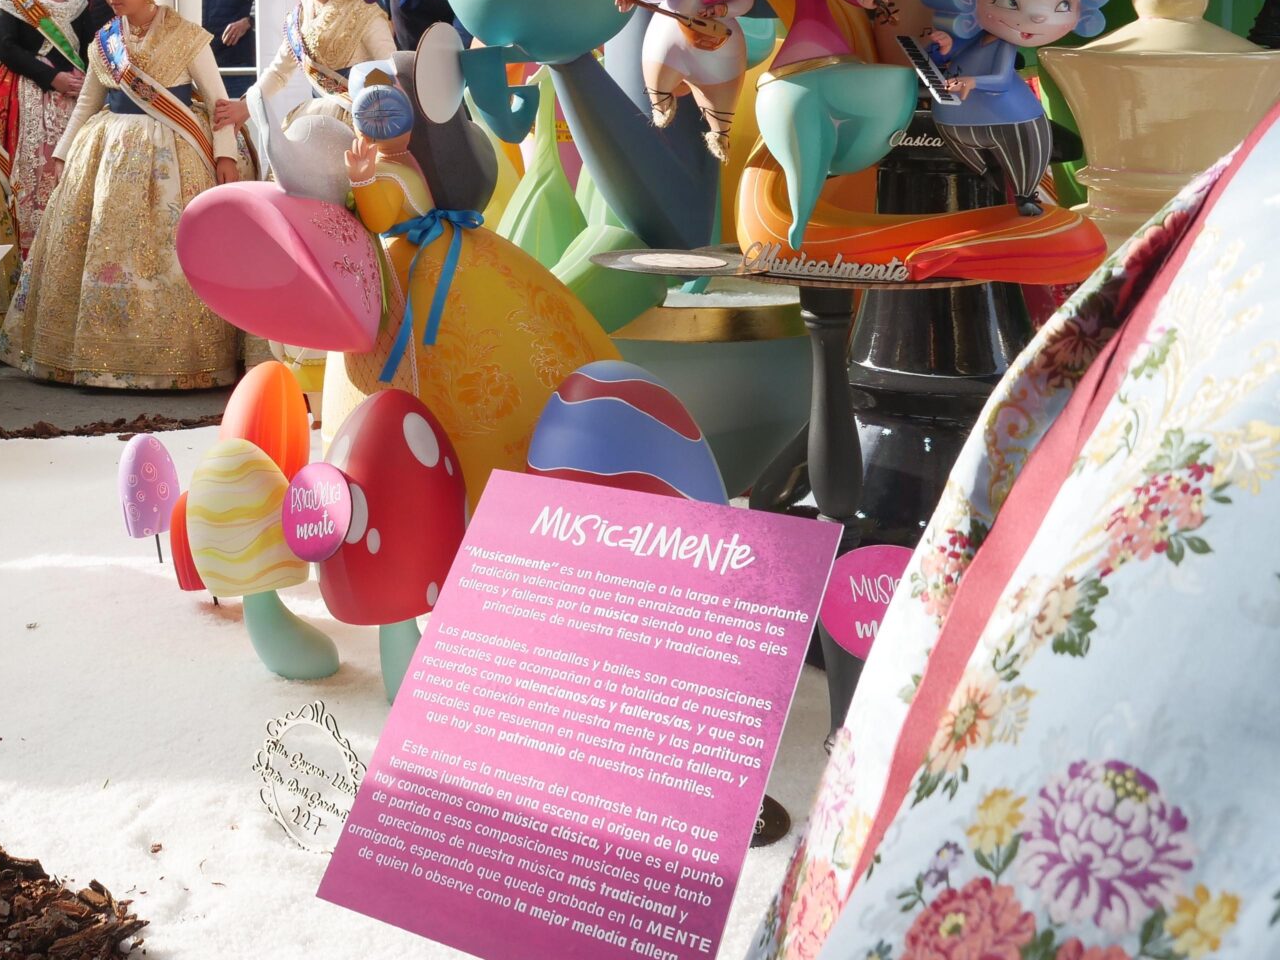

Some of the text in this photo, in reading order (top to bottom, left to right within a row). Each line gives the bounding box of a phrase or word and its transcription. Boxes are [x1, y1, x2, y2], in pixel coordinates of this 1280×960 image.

[889, 129, 945, 148] Clasica
[742, 241, 910, 282] Musicalmente
[296, 510, 336, 540] mente
[458, 576, 788, 656] falleros y falleras por la música siendo uno de los ejes
[470, 562, 785, 637] tradición valenciana que tan enraizada tenemos los
[481, 600, 741, 665] principales de nuestra fiesta y tradiciones.
[559, 565, 574, 576] es
[576, 568, 592, 579] un
[594, 569, 656, 593] homenaje
[657, 584, 667, 594] a
[669, 584, 683, 597] la
[684, 587, 719, 605] larga
[721, 597, 731, 607] e
[732, 596, 809, 623] importante
[421, 655, 477, 676] recuerdos
[479, 669, 512, 685] como
[607, 700, 618, 713] y
[695, 722, 706, 736] y
[707, 726, 736, 741] que
[737, 733, 764, 749] son
[434, 640, 762, 728] musicales que acompañan a la totalidad de nuestros
[437, 622, 773, 711] Los pasodobles, rondallas y bailes son composiciones
[401, 738, 719, 842] Este ninot es la muestra del contraste tan rico que
[425, 710, 715, 799] que hoy son patrimonio de nuestros infantiles.
[291, 805, 328, 836] 227
[371, 789, 712, 907] de partida a esas composiciones musicales que tanto
[373, 769, 724, 888] hoy conocemos como música clásica, y que es el punto
[347, 822, 712, 953] arraigada, esperando que quede grabada en la MENTE
[357, 845, 374, 860] de
[374, 852, 409, 872] quien
[410, 862, 423, 877] lo
[424, 869, 474, 895] observe
[475, 887, 512, 908] como
[512, 896, 527, 913] la
[528, 904, 570, 927] mejor
[570, 919, 628, 948] melodía
[377, 812, 446, 843] apreciamos
[447, 833, 465, 849] de
[466, 841, 515, 865] nuestra
[516, 857, 565, 882] música
[566, 873, 597, 892] más
[599, 881, 677, 918] tradicional
[678, 909, 689, 924] y
